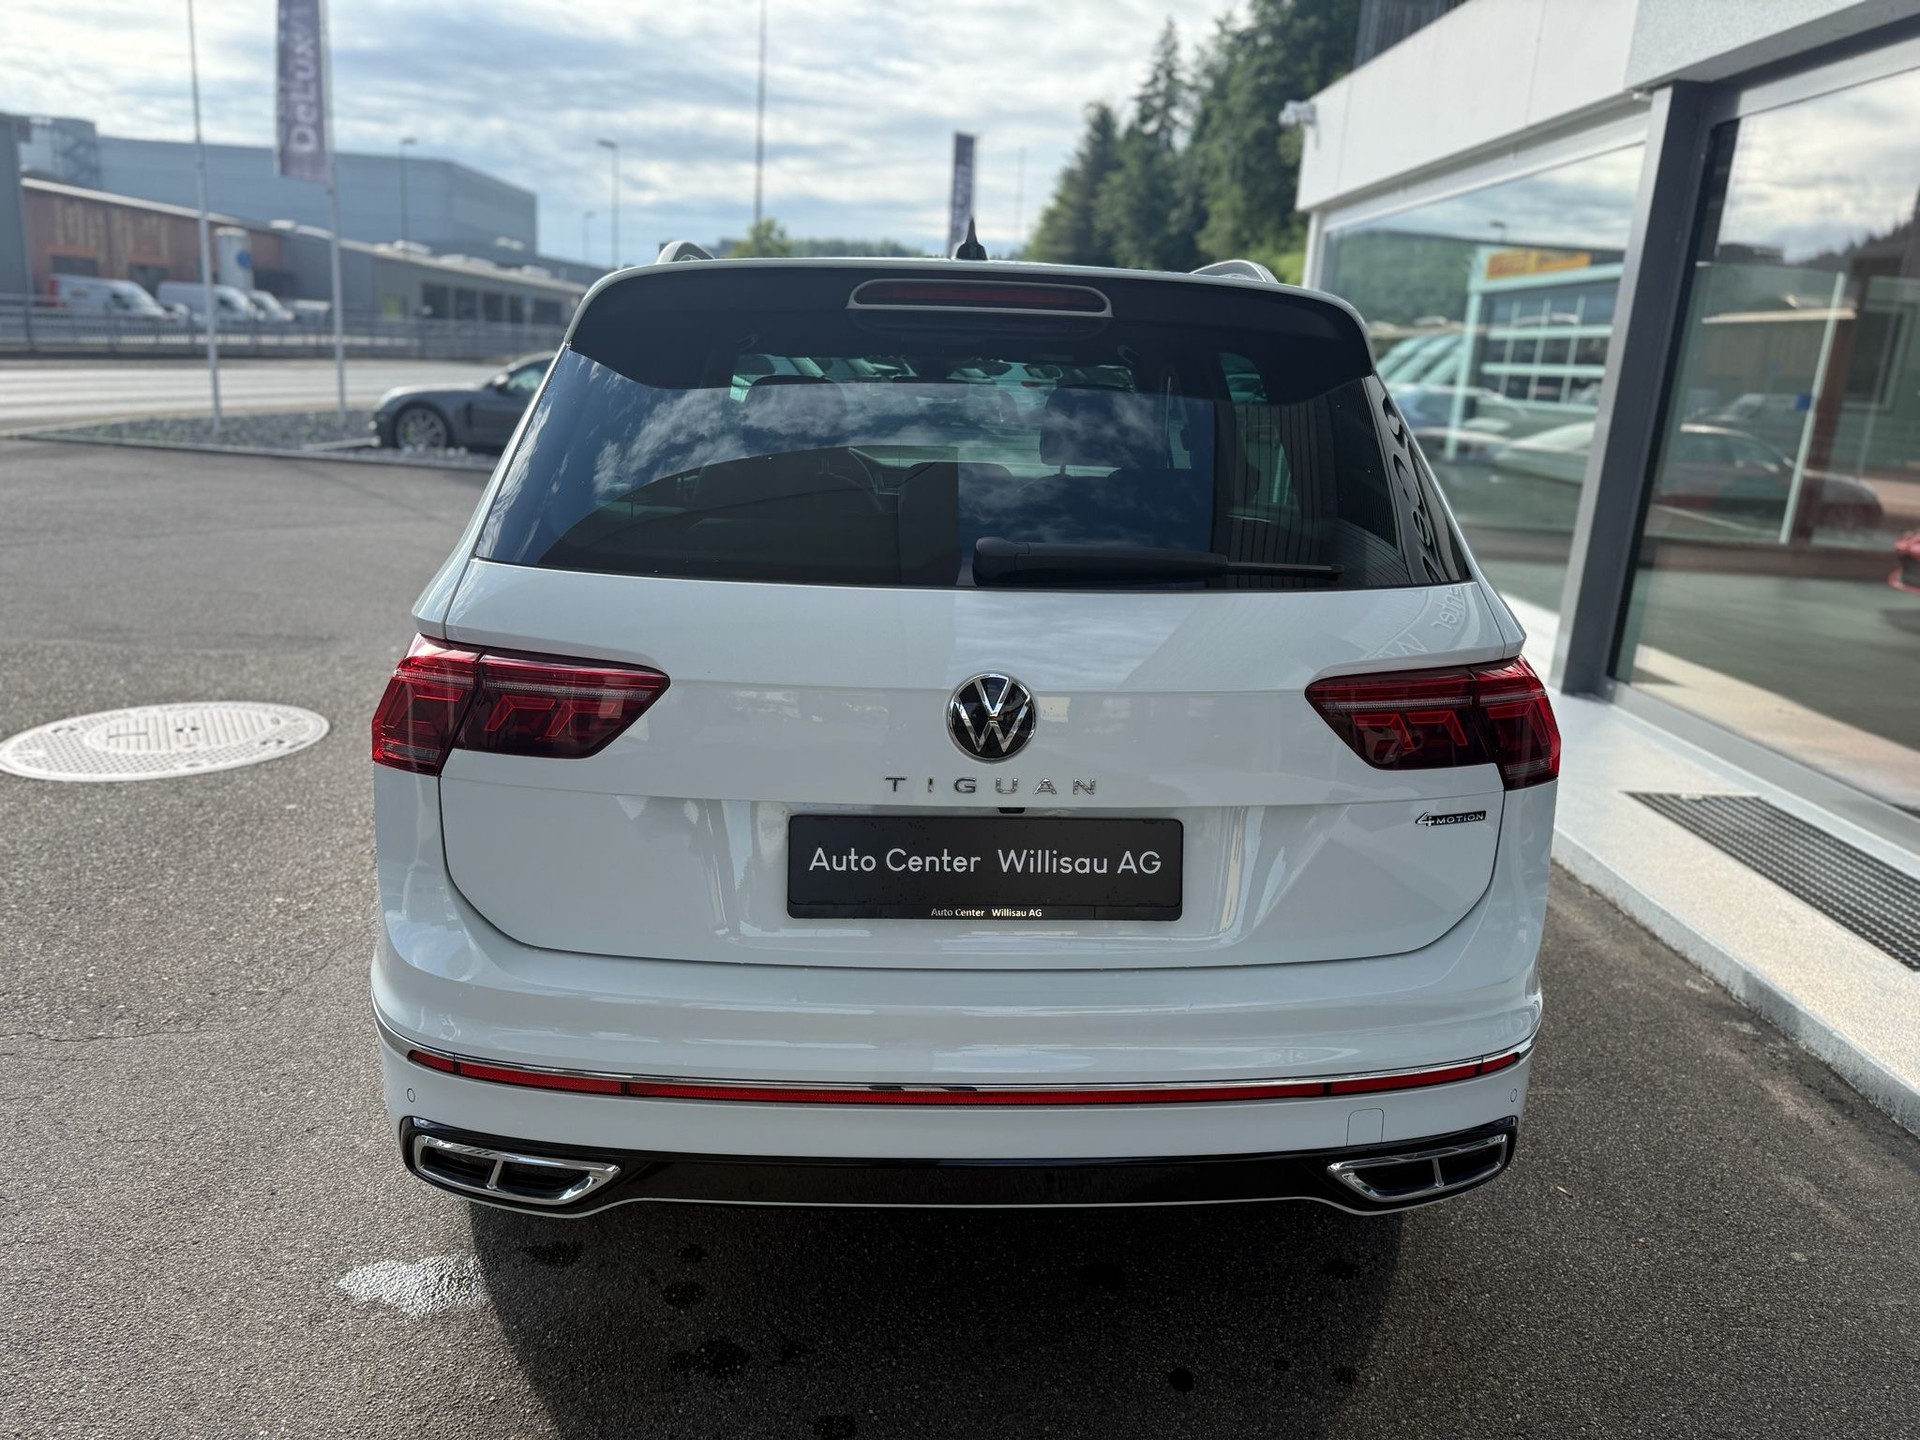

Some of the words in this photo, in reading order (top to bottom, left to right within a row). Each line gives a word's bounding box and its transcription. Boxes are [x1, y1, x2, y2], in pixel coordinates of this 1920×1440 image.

[885, 776, 1096, 796] TIGUAN
[808, 847, 877, 873] Auto
[886, 847, 982, 873] Center
[997, 848, 1108, 875] Willisau
[1116, 850, 1162, 875] AG
[931, 908, 953, 917] Auto
[954, 908, 985, 917] Center
[991, 908, 1027, 918] Willisau
[1028, 909, 1043, 918] AG
